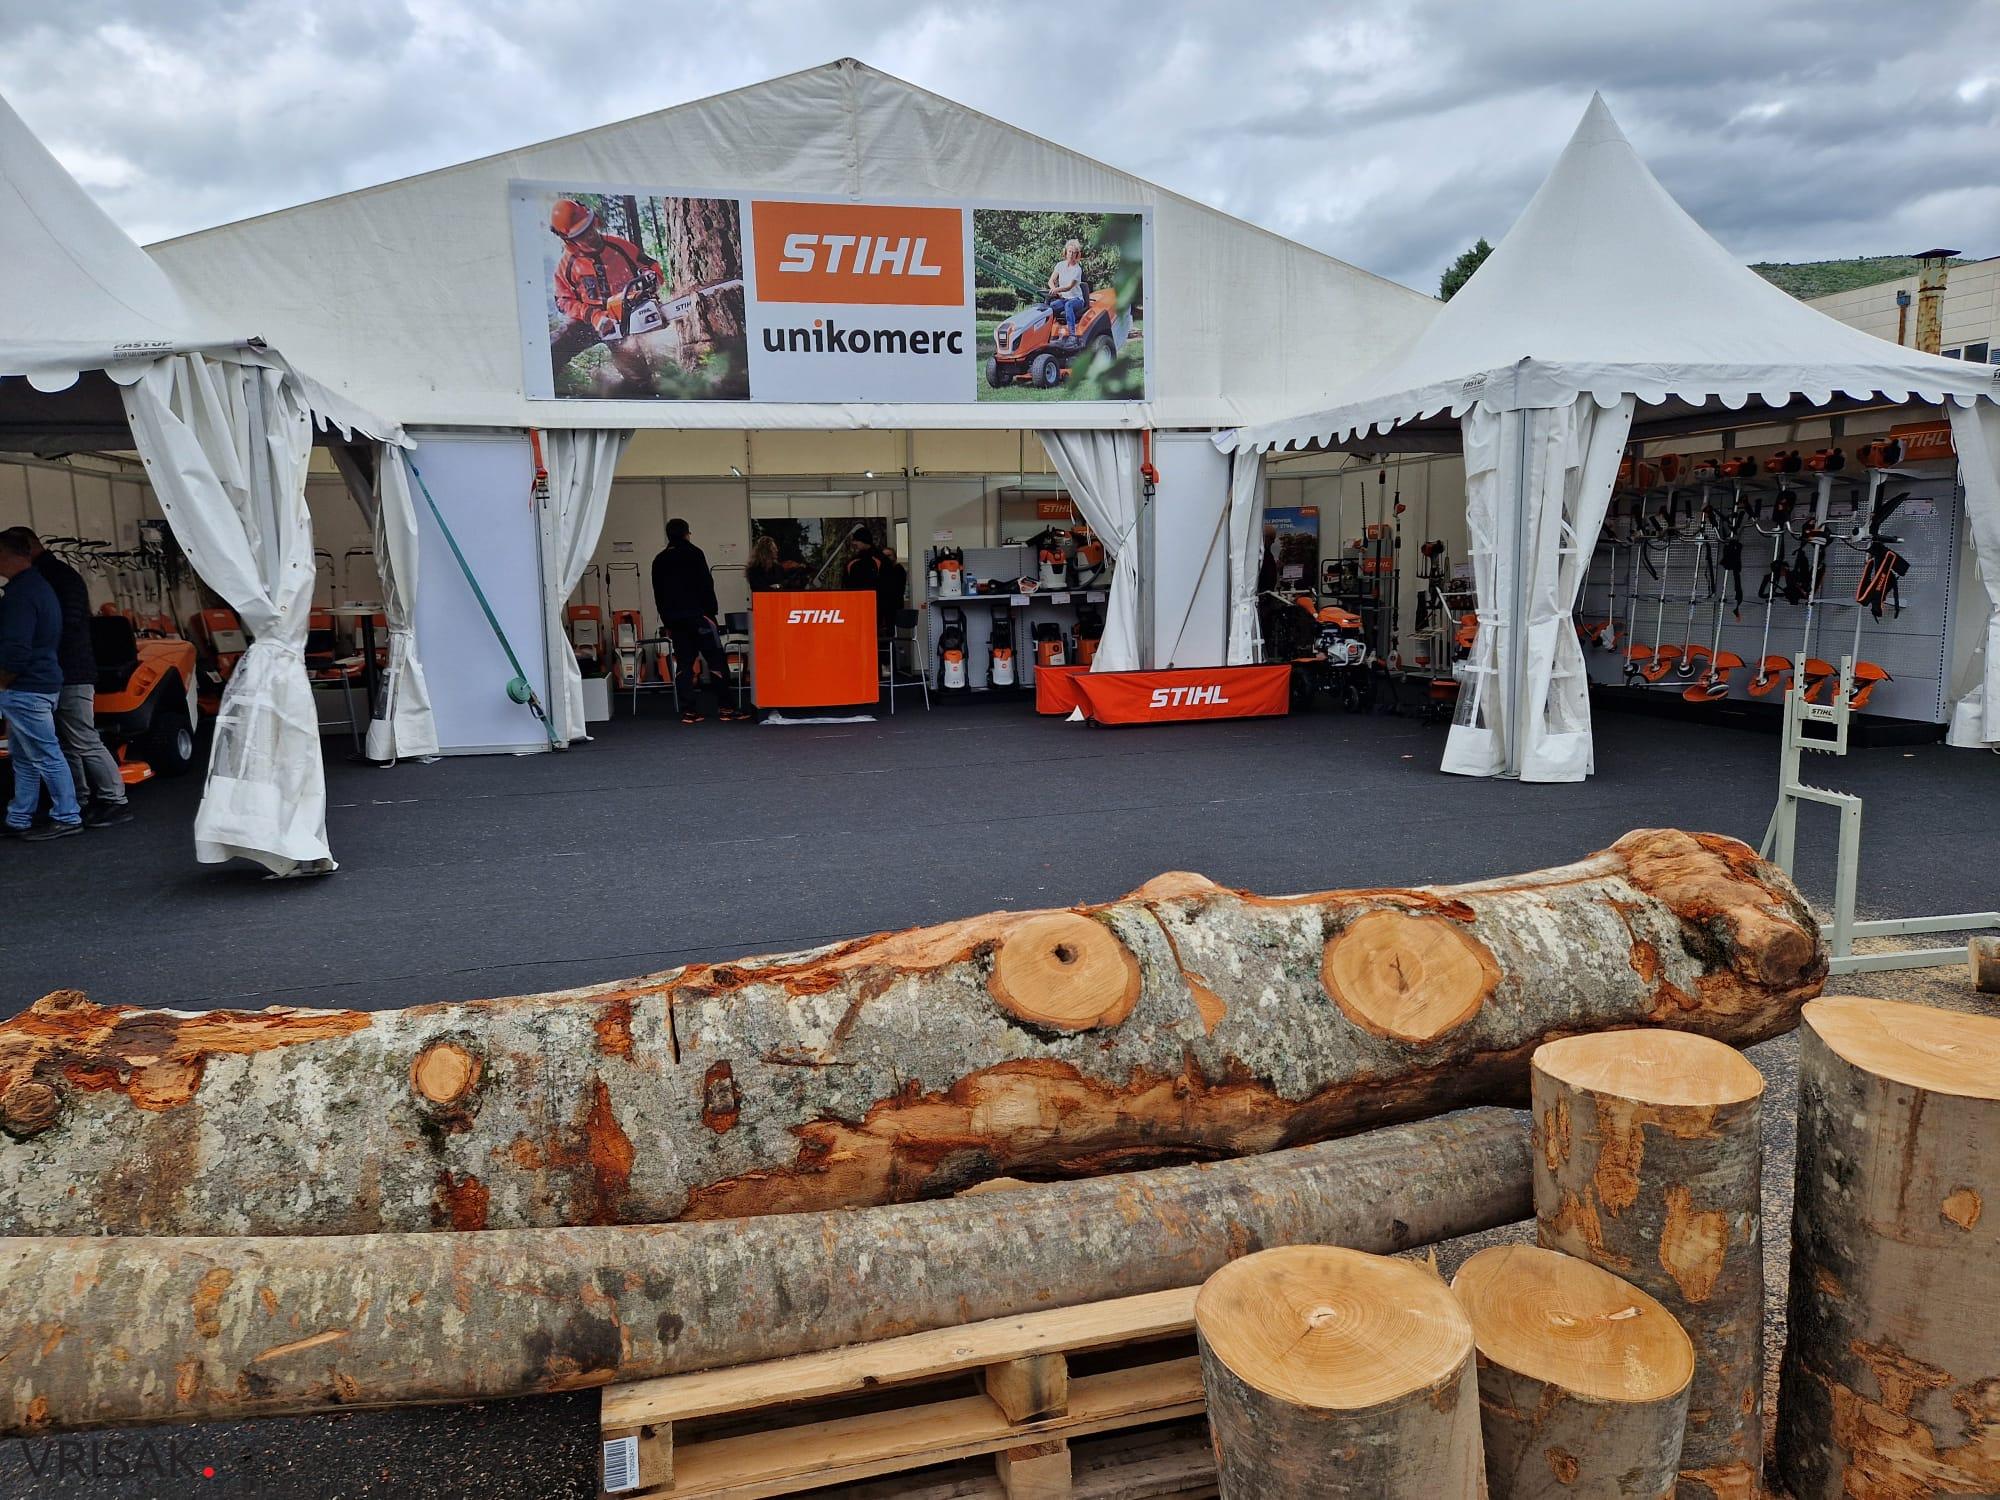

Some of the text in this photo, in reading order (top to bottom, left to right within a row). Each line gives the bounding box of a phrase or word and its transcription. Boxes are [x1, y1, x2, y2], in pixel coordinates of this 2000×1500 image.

[779, 233, 942, 277] STIHL
[675, 300, 692, 312] STIH
[763, 319, 964, 356] unikomerc
[786, 609, 845, 624] STIHL
[1149, 685, 1229, 709] STIHL
[1811, 708, 1833, 717] STIHL
